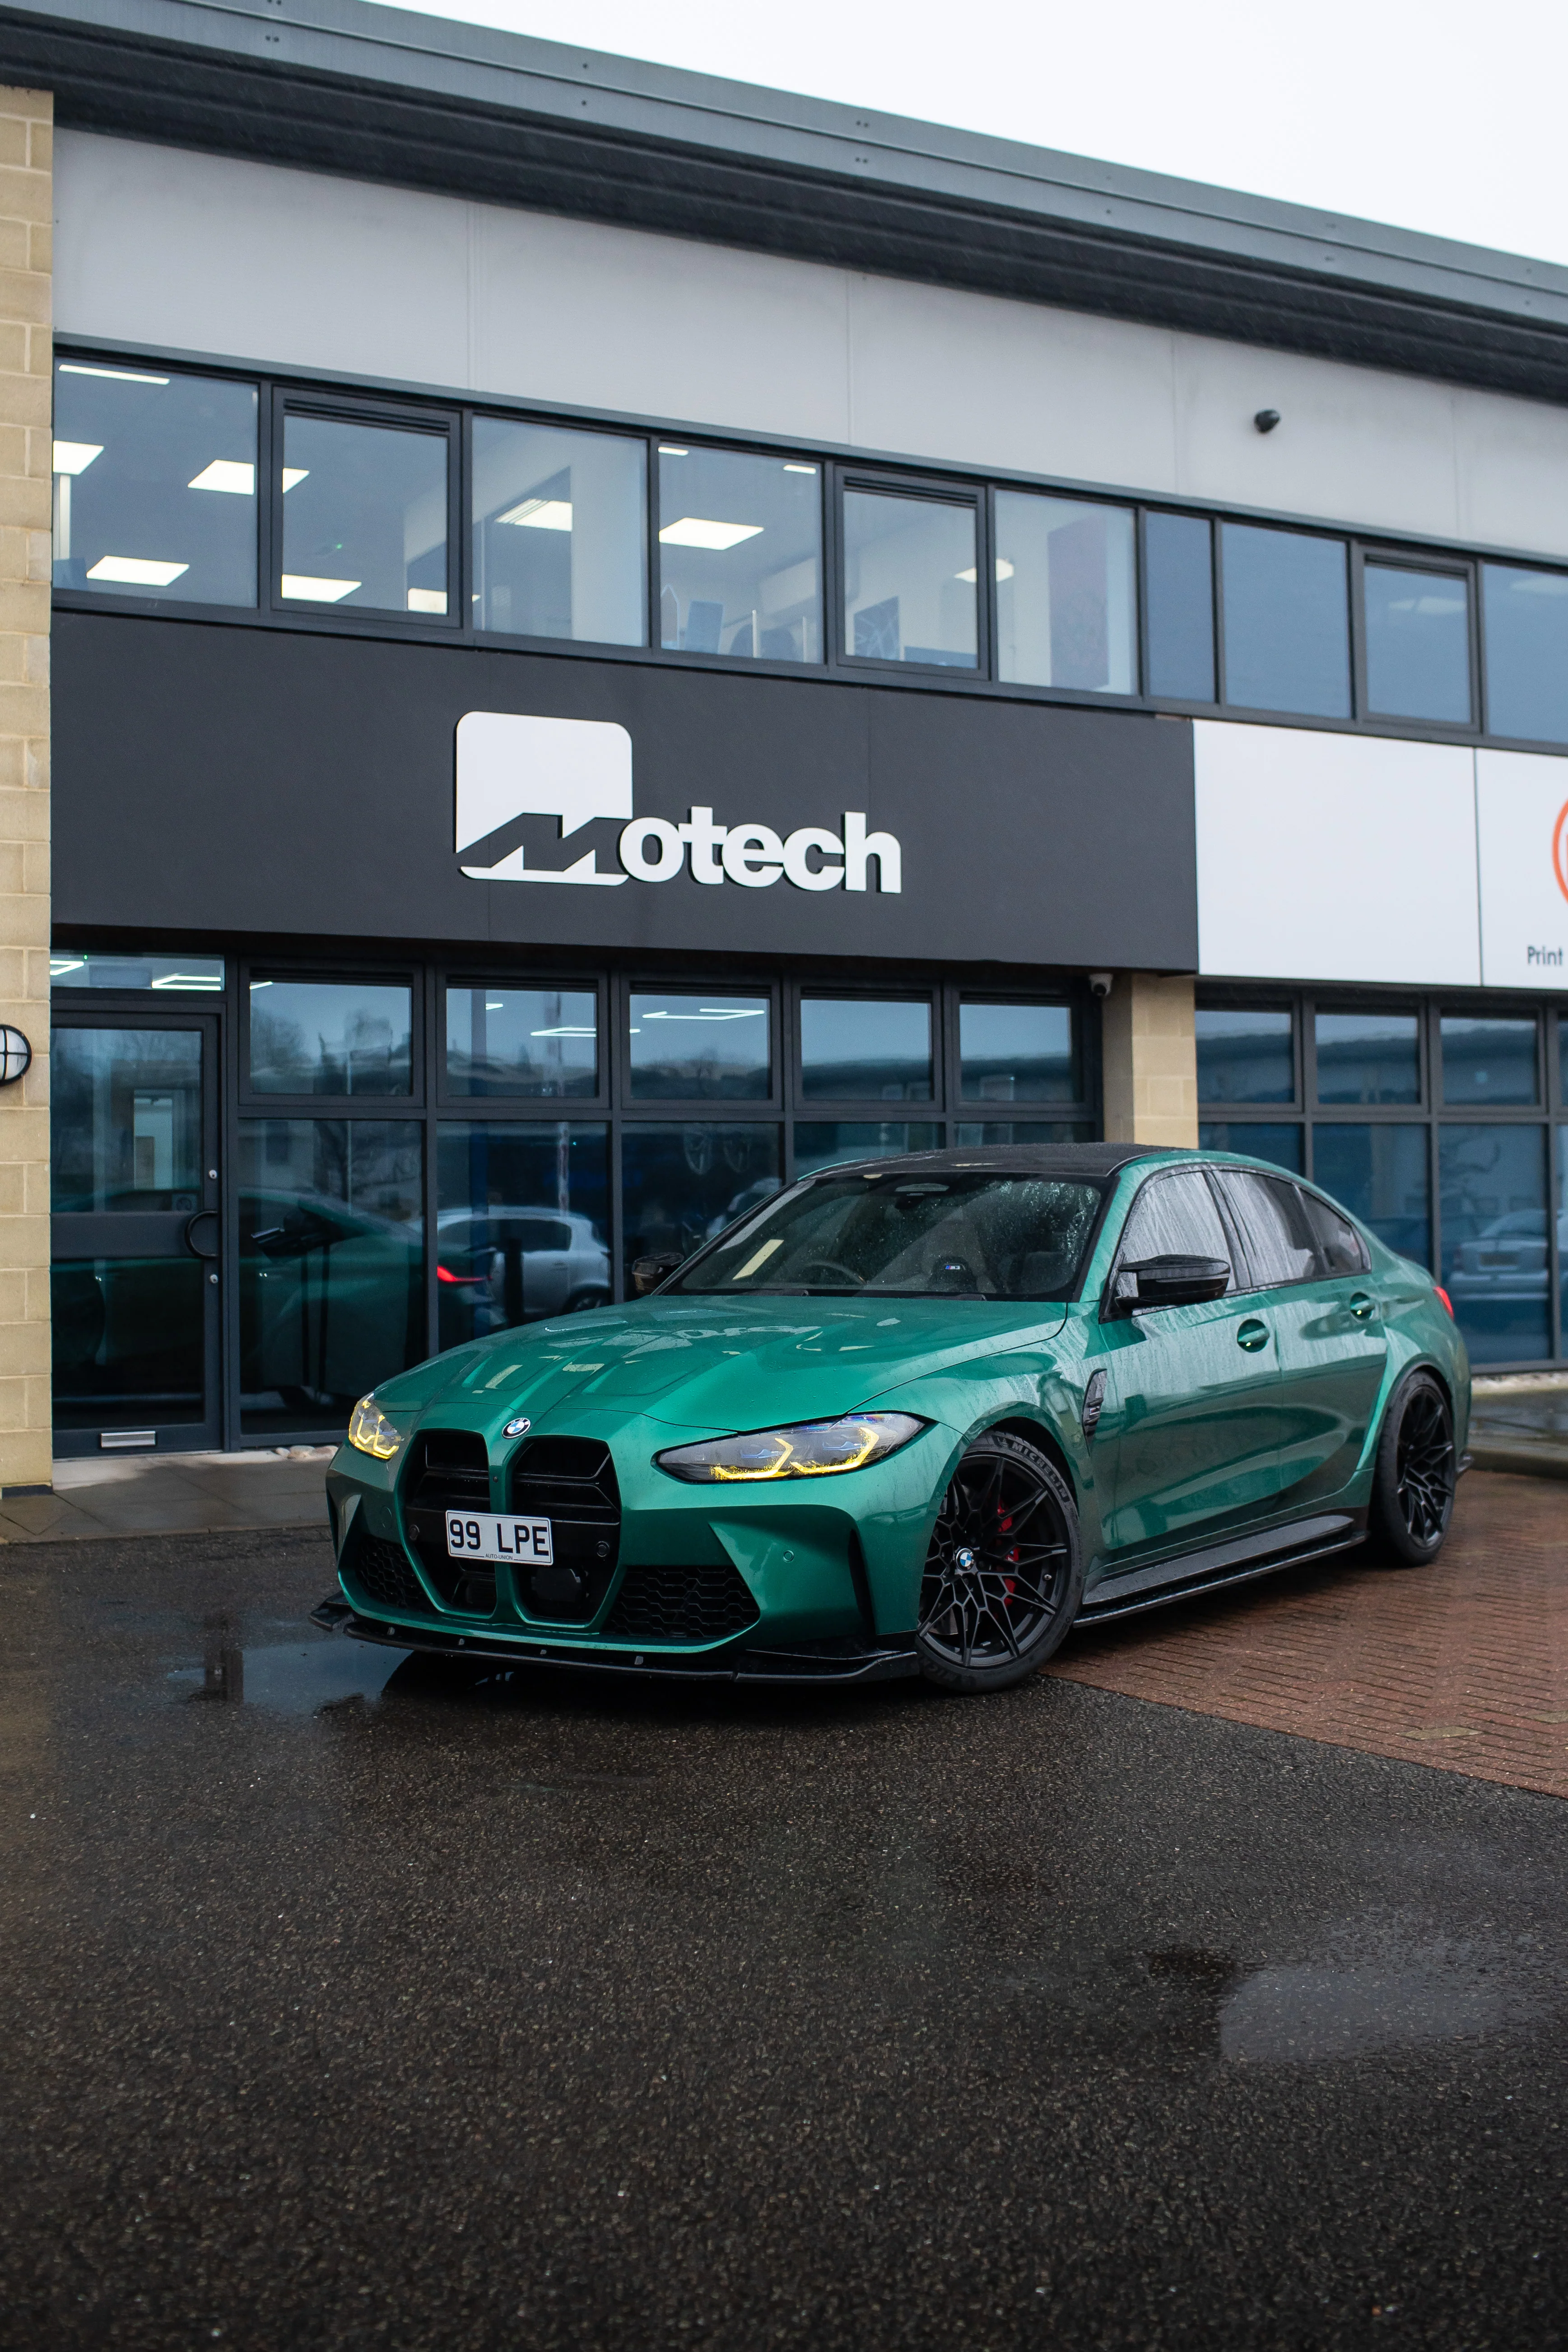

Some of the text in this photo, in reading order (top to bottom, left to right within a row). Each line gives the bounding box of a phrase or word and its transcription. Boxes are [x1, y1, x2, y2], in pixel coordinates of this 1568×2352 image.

[1527, 945, 1563, 965] Print
[1011, 1442, 1067, 1498] MICHELIN
[450, 1519, 549, 1556] 99 LPE
